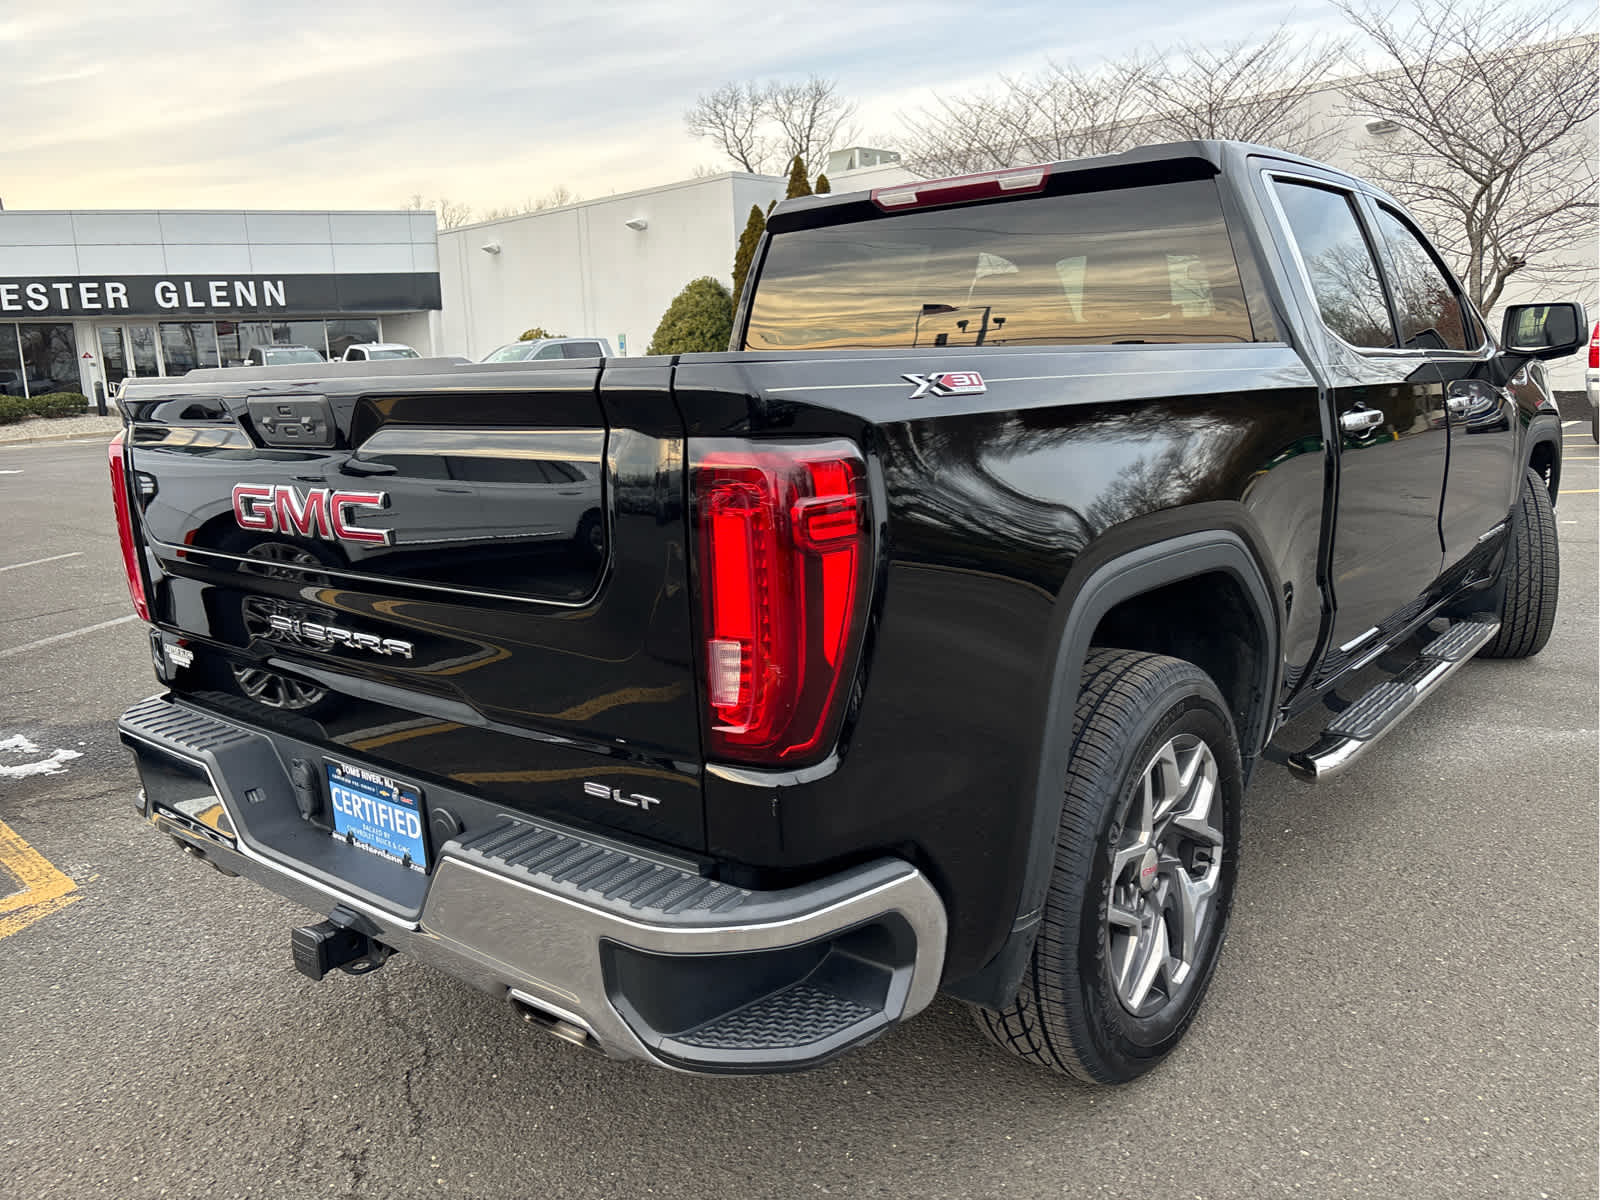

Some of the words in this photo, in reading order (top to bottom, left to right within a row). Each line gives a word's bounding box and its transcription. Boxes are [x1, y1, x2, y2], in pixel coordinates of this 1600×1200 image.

[0, 281, 129, 311] ESTER
[154, 280, 287, 309] GLENN
[232, 482, 396, 547] GMC
[269, 614, 415, 659] SIERRA
[341, 763, 360, 778] TOMS
[331, 786, 421, 839] CERTIFIED
[583, 781, 661, 811] SLT
